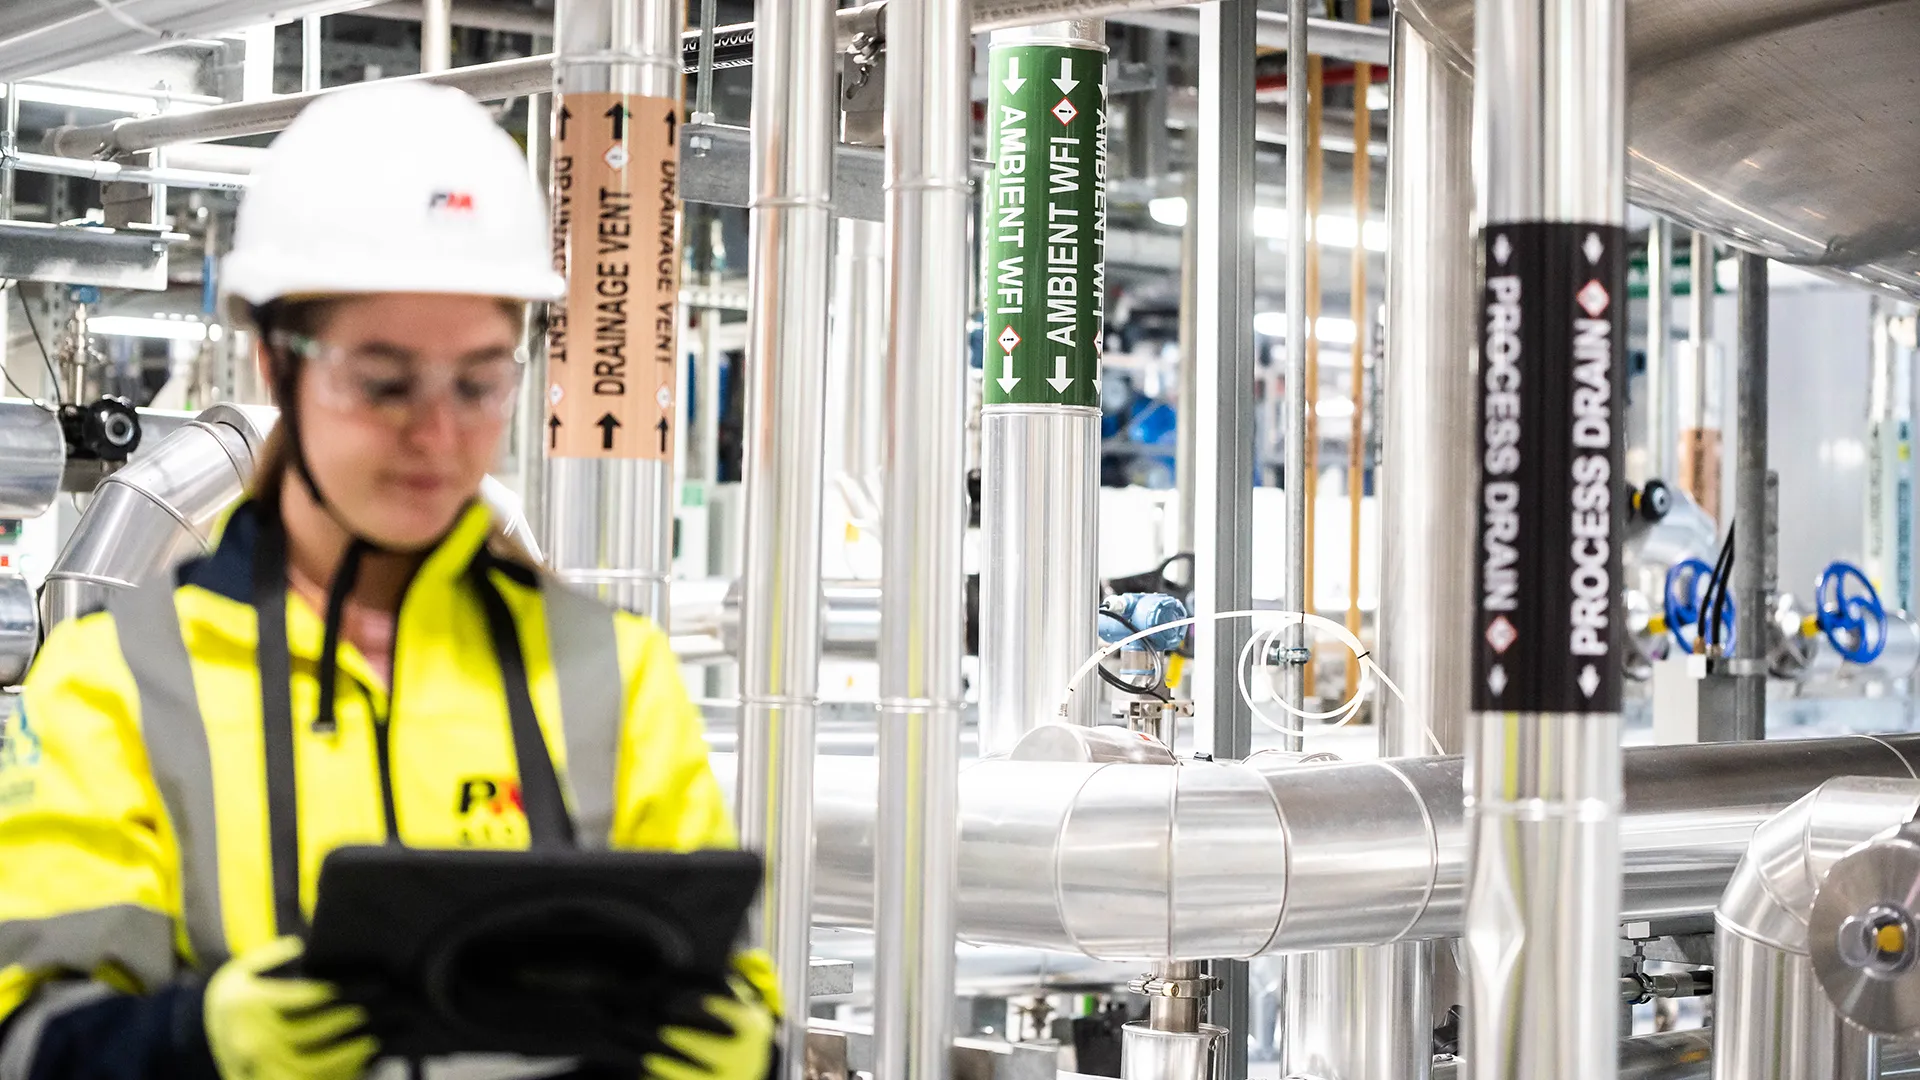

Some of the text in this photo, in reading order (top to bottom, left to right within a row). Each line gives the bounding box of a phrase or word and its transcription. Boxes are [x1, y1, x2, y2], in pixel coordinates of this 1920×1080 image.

[597, 185, 632, 255] VENT
[654, 159, 676, 367] DRAINAGE VENT
[996, 104, 1027, 314] AMBIENT WFI
[1046, 136, 1080, 348] AMBIENT WFI
[593, 261, 630, 397] DRAINAGE
[1482, 275, 1522, 612] PROCESS DRAIN
[1570, 317, 1612, 656] PROCESS DRAIN
